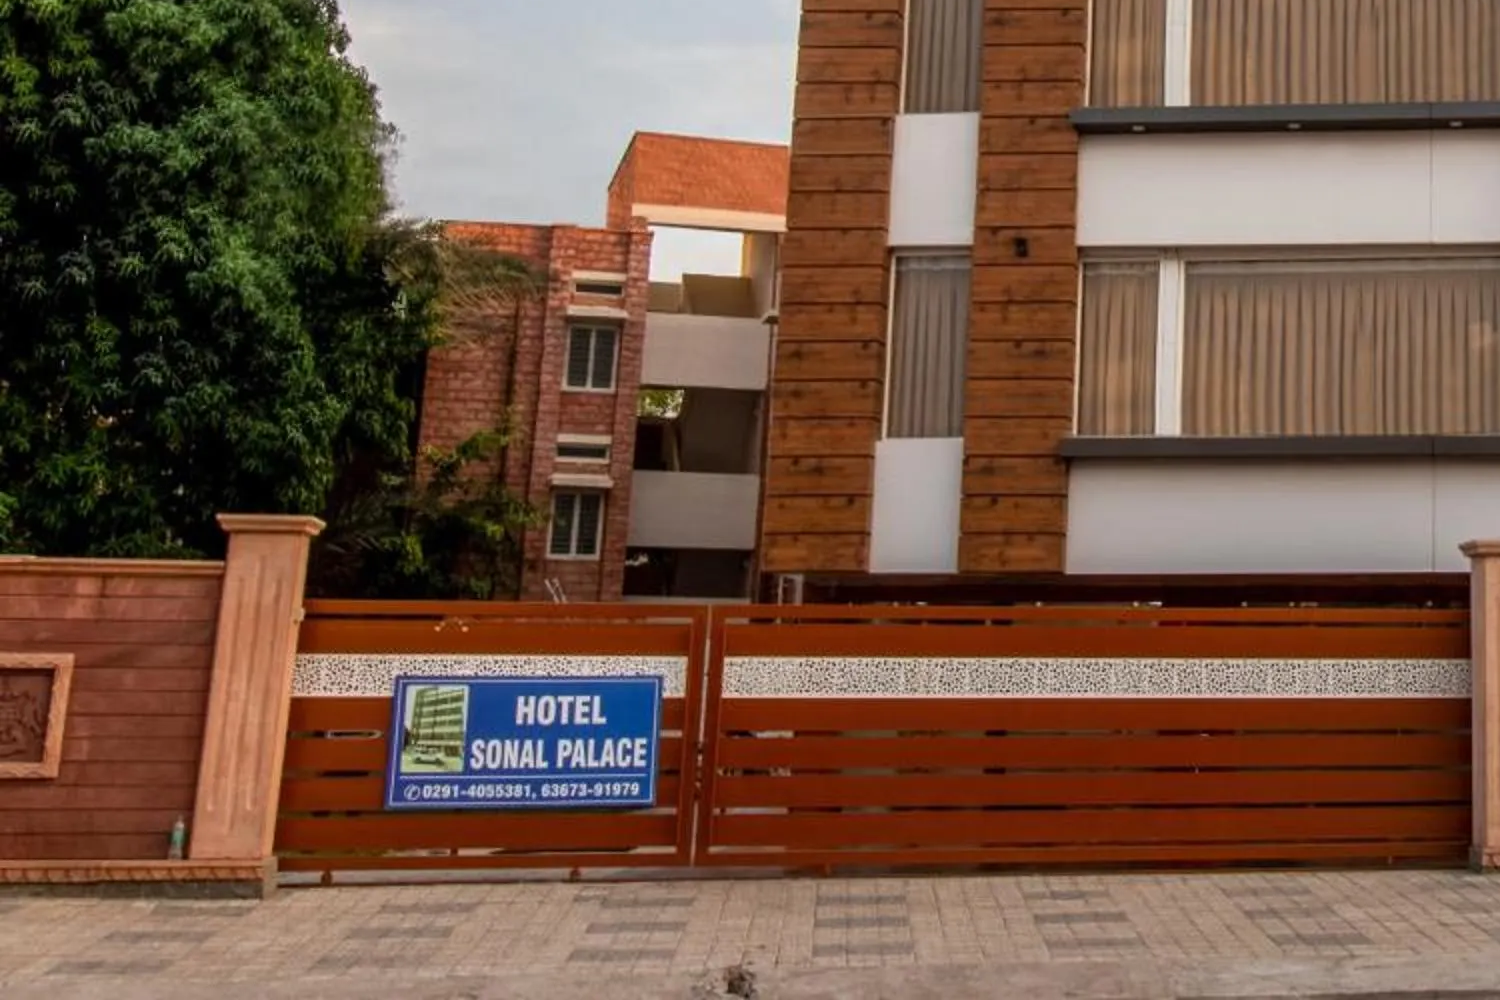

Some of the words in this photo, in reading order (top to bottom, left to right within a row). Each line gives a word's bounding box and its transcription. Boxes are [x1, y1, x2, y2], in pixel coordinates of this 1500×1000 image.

[515, 695, 607, 726] HOTEL
[469, 738, 549, 770] SONAL
[556, 737, 648, 769] PALACE
